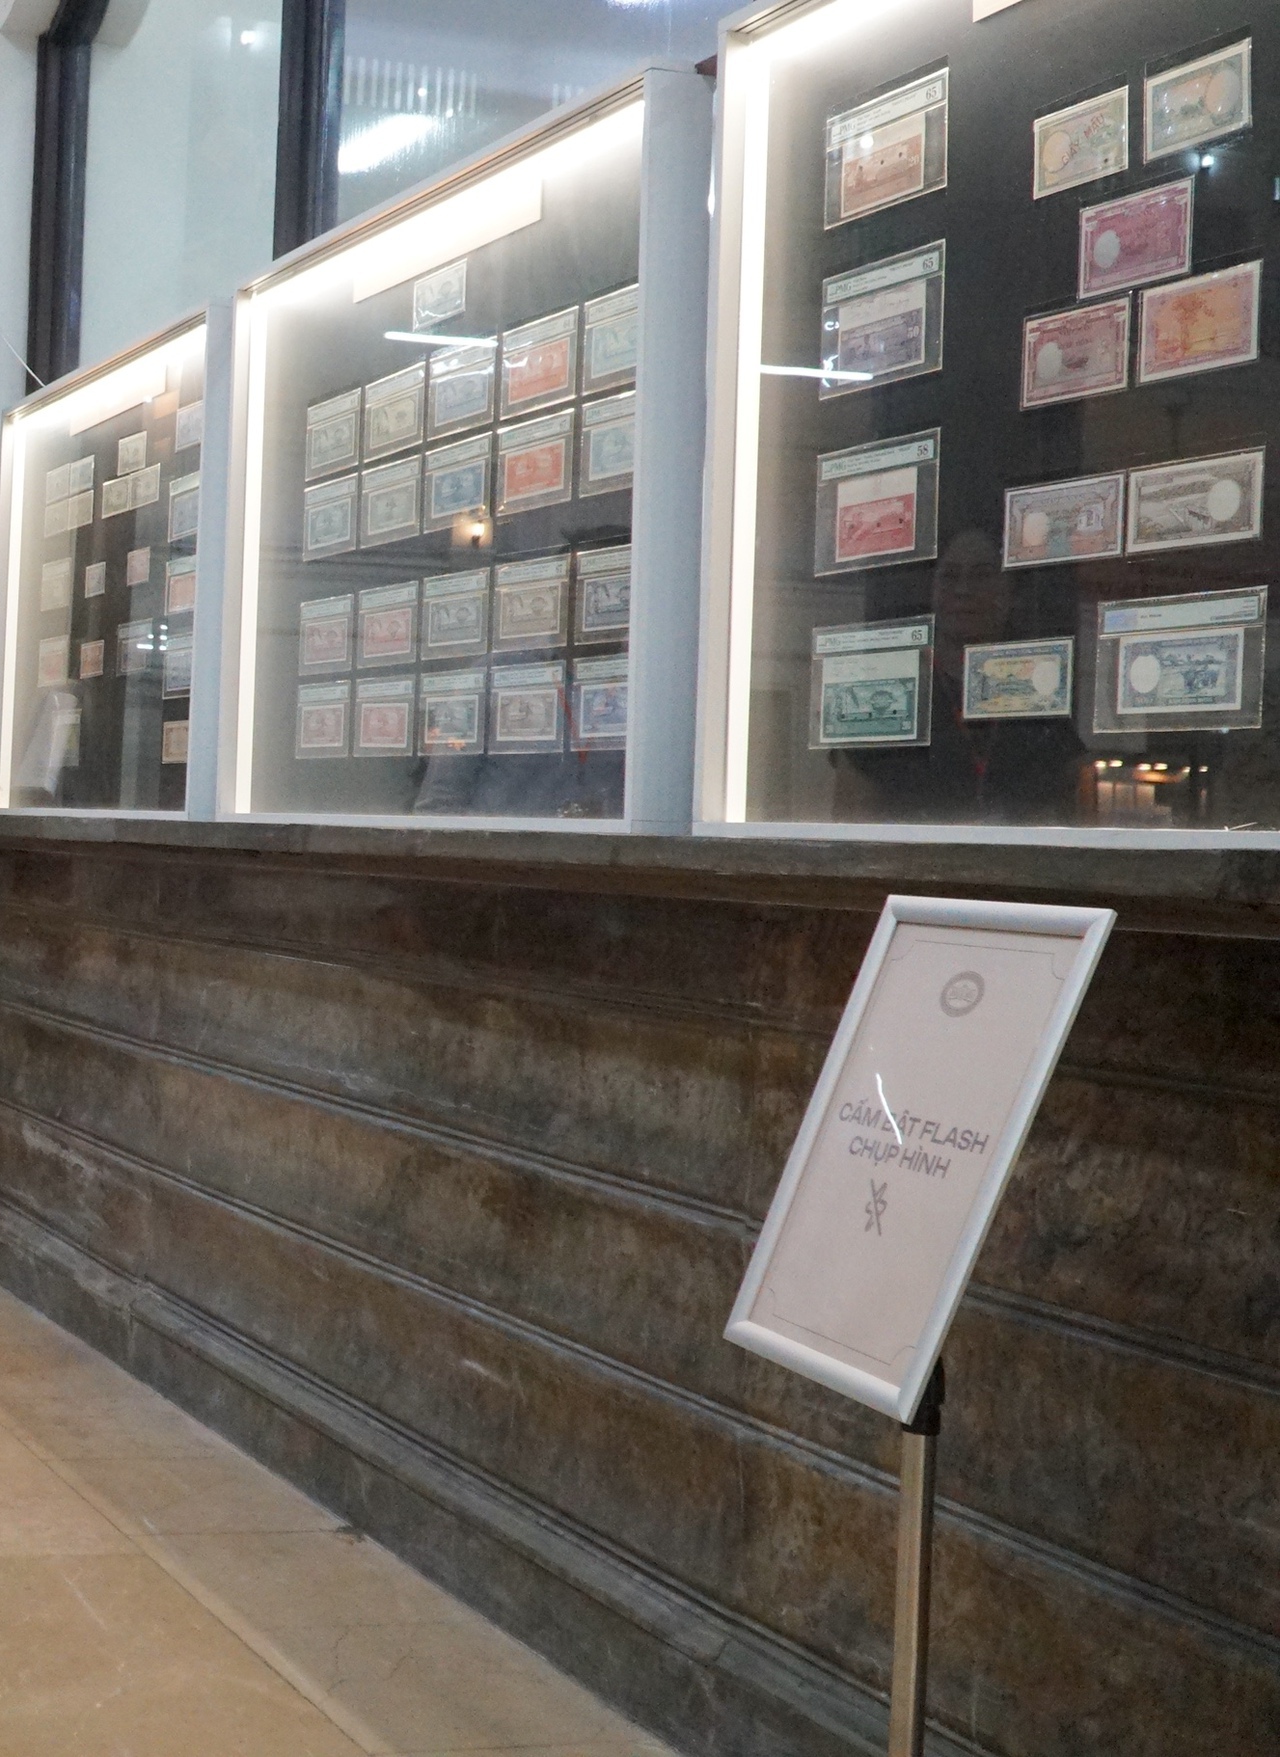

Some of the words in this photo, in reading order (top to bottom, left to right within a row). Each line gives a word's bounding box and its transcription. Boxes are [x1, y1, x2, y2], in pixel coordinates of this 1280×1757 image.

[925, 86, 937, 100] 65
[839, 120, 856, 135] PMG
[922, 257, 934, 270] 65
[835, 282, 852, 294] PMG
[916, 443, 929, 457] 58
[911, 629, 923, 641] 65
[838, 1098, 881, 1128] CẤM
[918, 1120, 989, 1154] FLASH
[848, 1135, 900, 1167] CHỤP
[899, 1145, 951, 1179] HÌNH
